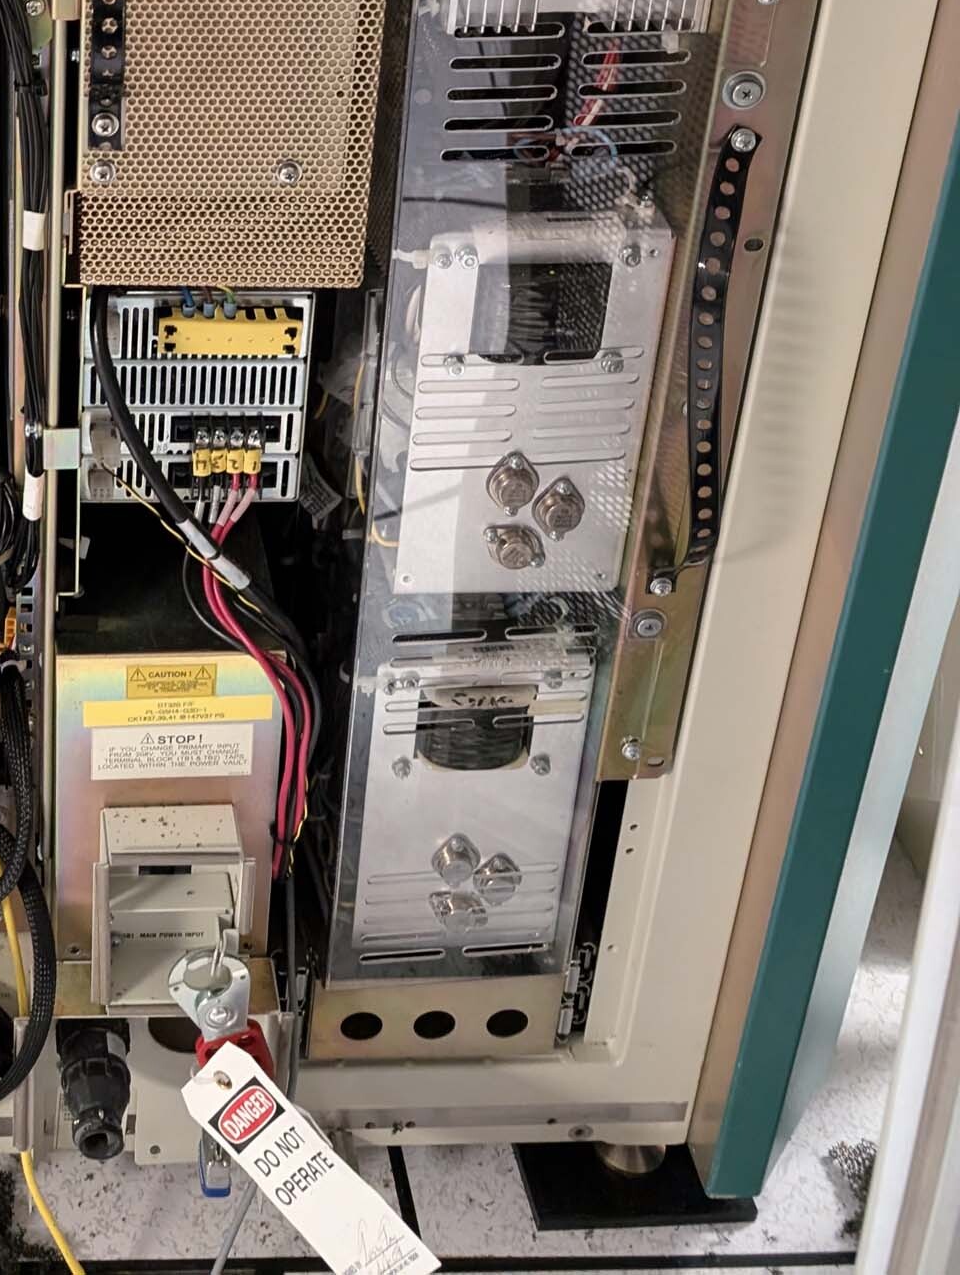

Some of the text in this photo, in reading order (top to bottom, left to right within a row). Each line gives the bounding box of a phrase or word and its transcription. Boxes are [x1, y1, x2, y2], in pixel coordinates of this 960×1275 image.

[158, 734, 195, 745] STOP
[223, 1090, 273, 1140] DANGER
[254, 1126, 305, 1177] DO NOT
[275, 1151, 335, 1206] OPERATE
